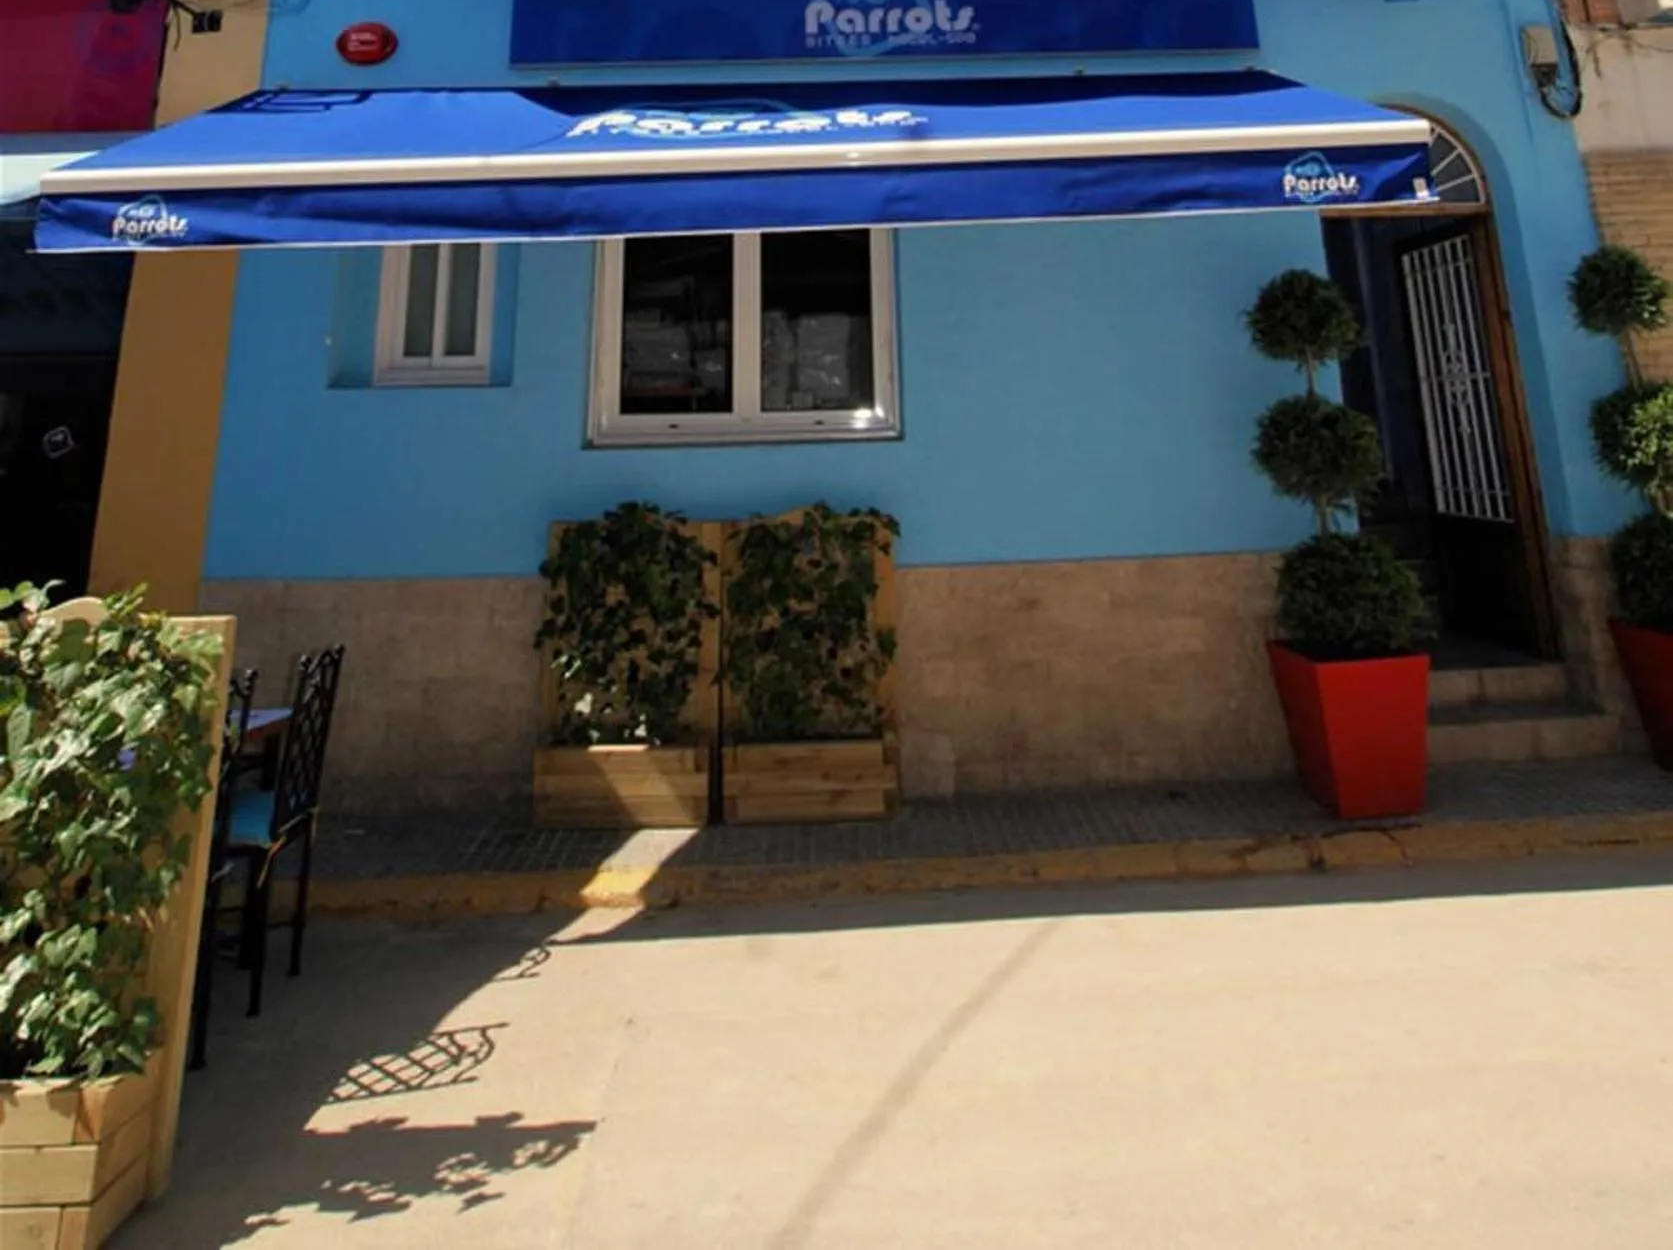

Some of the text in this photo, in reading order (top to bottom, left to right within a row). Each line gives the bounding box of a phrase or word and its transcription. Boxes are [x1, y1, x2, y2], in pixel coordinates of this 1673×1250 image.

[804, 0, 976, 34] Parrots
[1283, 171, 1358, 192] Parrots
[112, 214, 188, 237] Parrots
